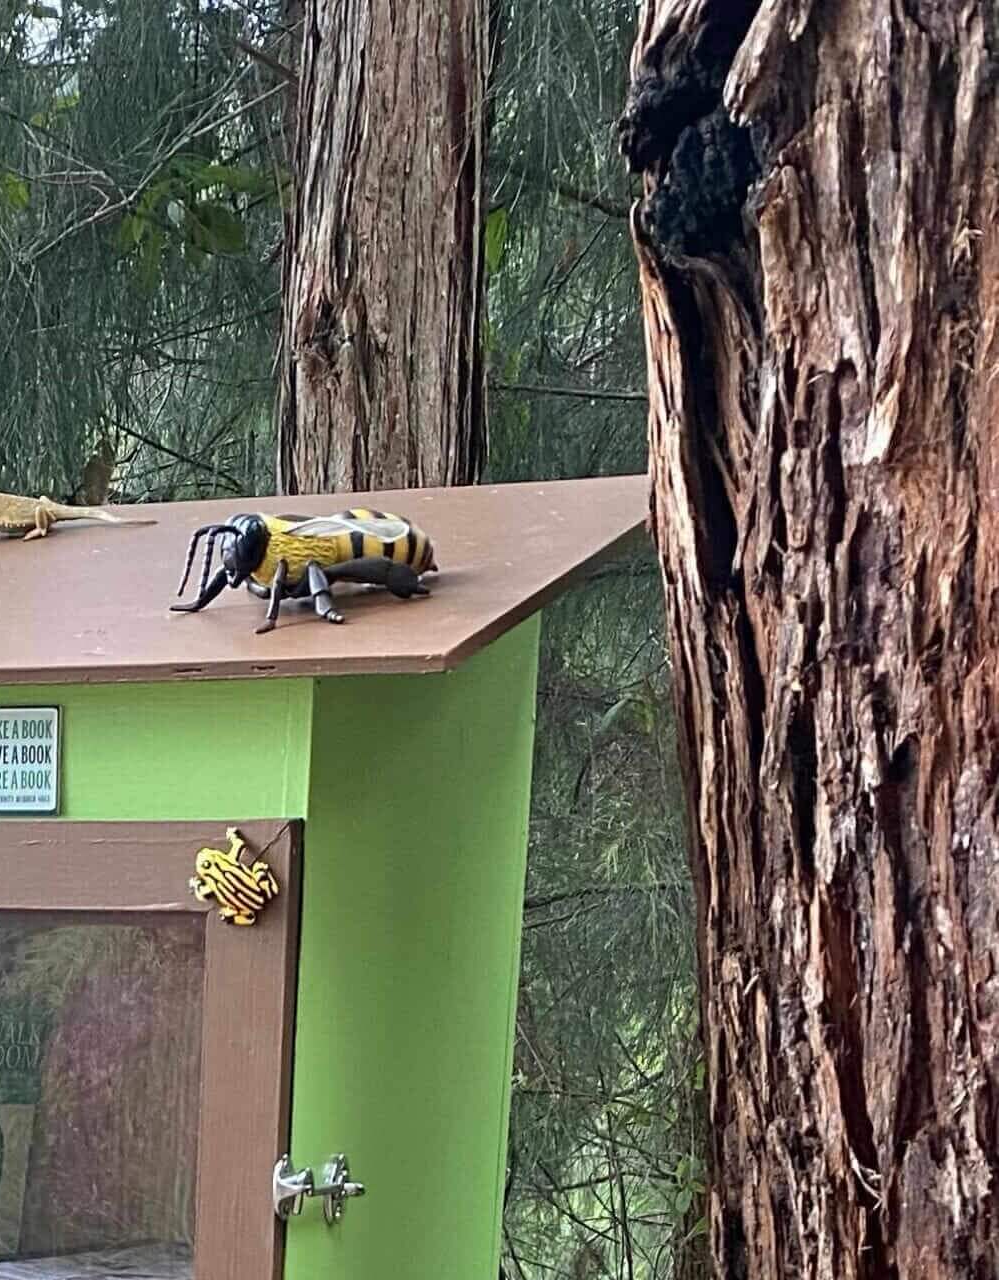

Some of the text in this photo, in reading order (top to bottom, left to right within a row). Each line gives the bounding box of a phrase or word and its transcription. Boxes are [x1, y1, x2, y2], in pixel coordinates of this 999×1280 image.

[11, 720, 19, 739] A
[22, 720, 53, 739] BOOK
[11, 745, 19, 765] A
[22, 745, 52, 765] BOOK
[10, 770, 18, 789] A
[22, 770, 51, 789] BOOK
